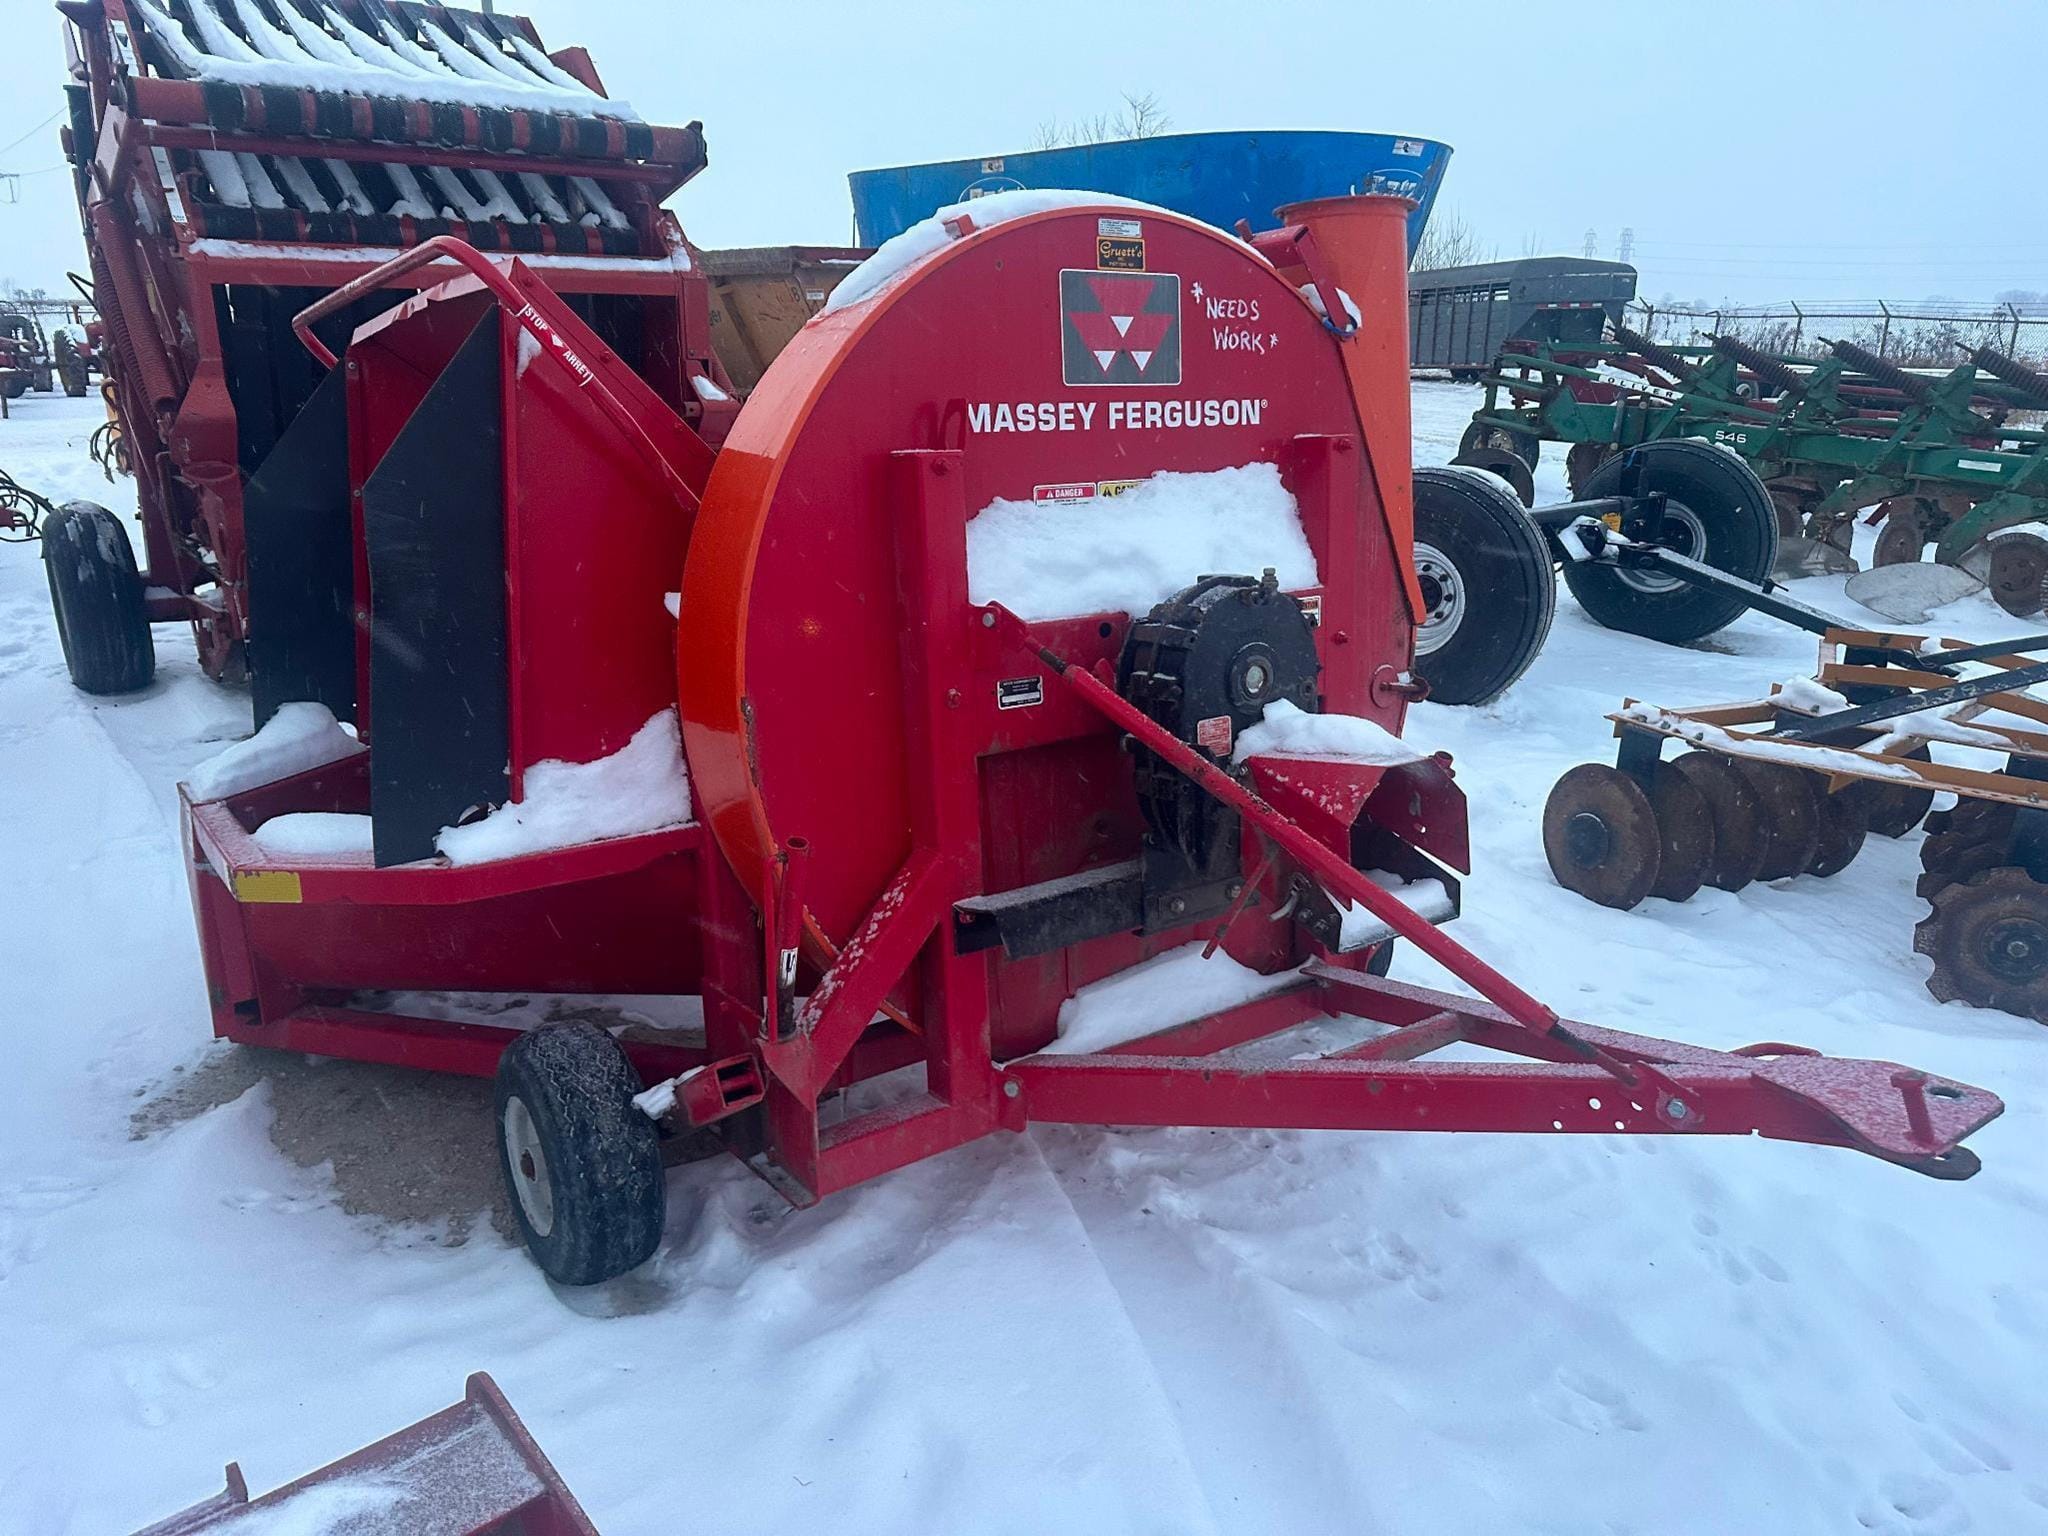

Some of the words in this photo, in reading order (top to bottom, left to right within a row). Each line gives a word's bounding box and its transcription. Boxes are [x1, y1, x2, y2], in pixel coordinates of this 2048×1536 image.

[524, 307, 548, 331] STOP
[1206, 297, 1260, 321] NEEDS
[1212, 326, 1265, 354] WORK
[562, 350, 591, 379] ARRET
[1607, 377, 1674, 399] OLIVER
[968, 402, 1097, 433] MASSEY
[1055, 488, 1084, 498] DANGER
